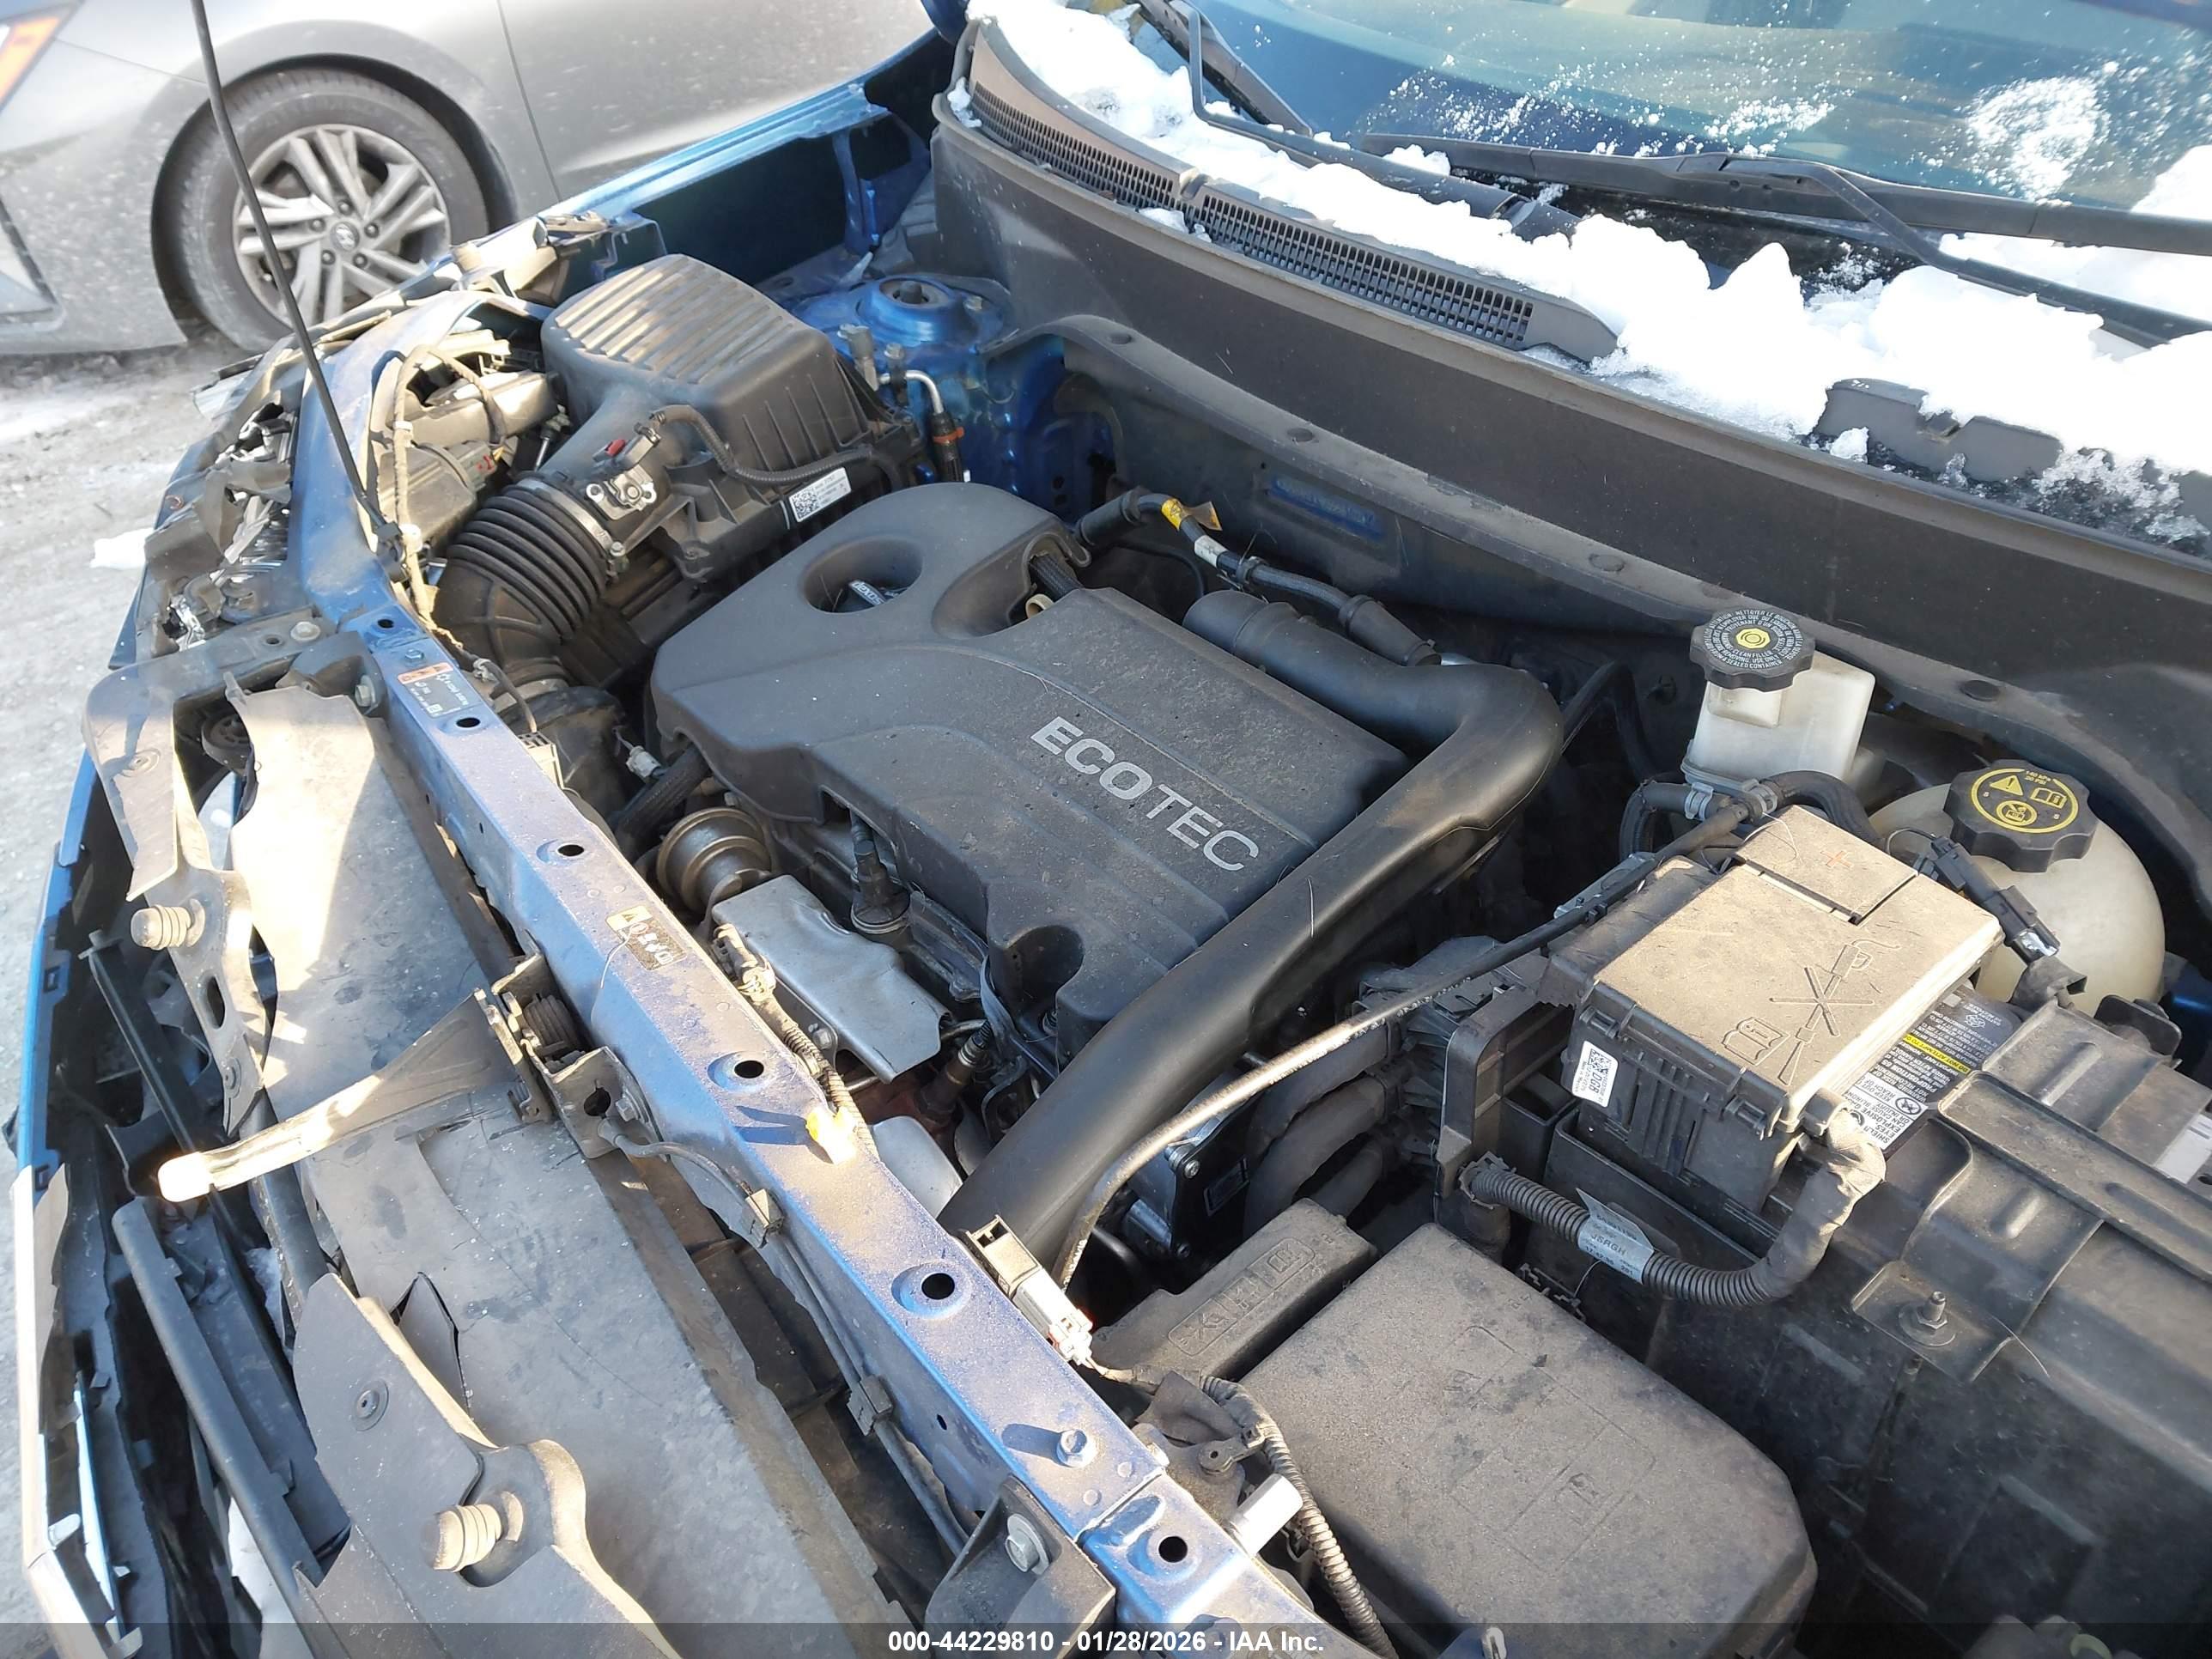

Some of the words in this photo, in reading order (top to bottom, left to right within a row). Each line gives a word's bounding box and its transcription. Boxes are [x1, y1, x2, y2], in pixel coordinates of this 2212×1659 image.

[1030, 716, 1259, 872] ECOTEC
[1891, 1065, 1937, 1093] PROPOSITION
[1861, 1107, 1901, 1133] EXPLOSIVE
[1891, 1118, 1905, 1128] CAN
